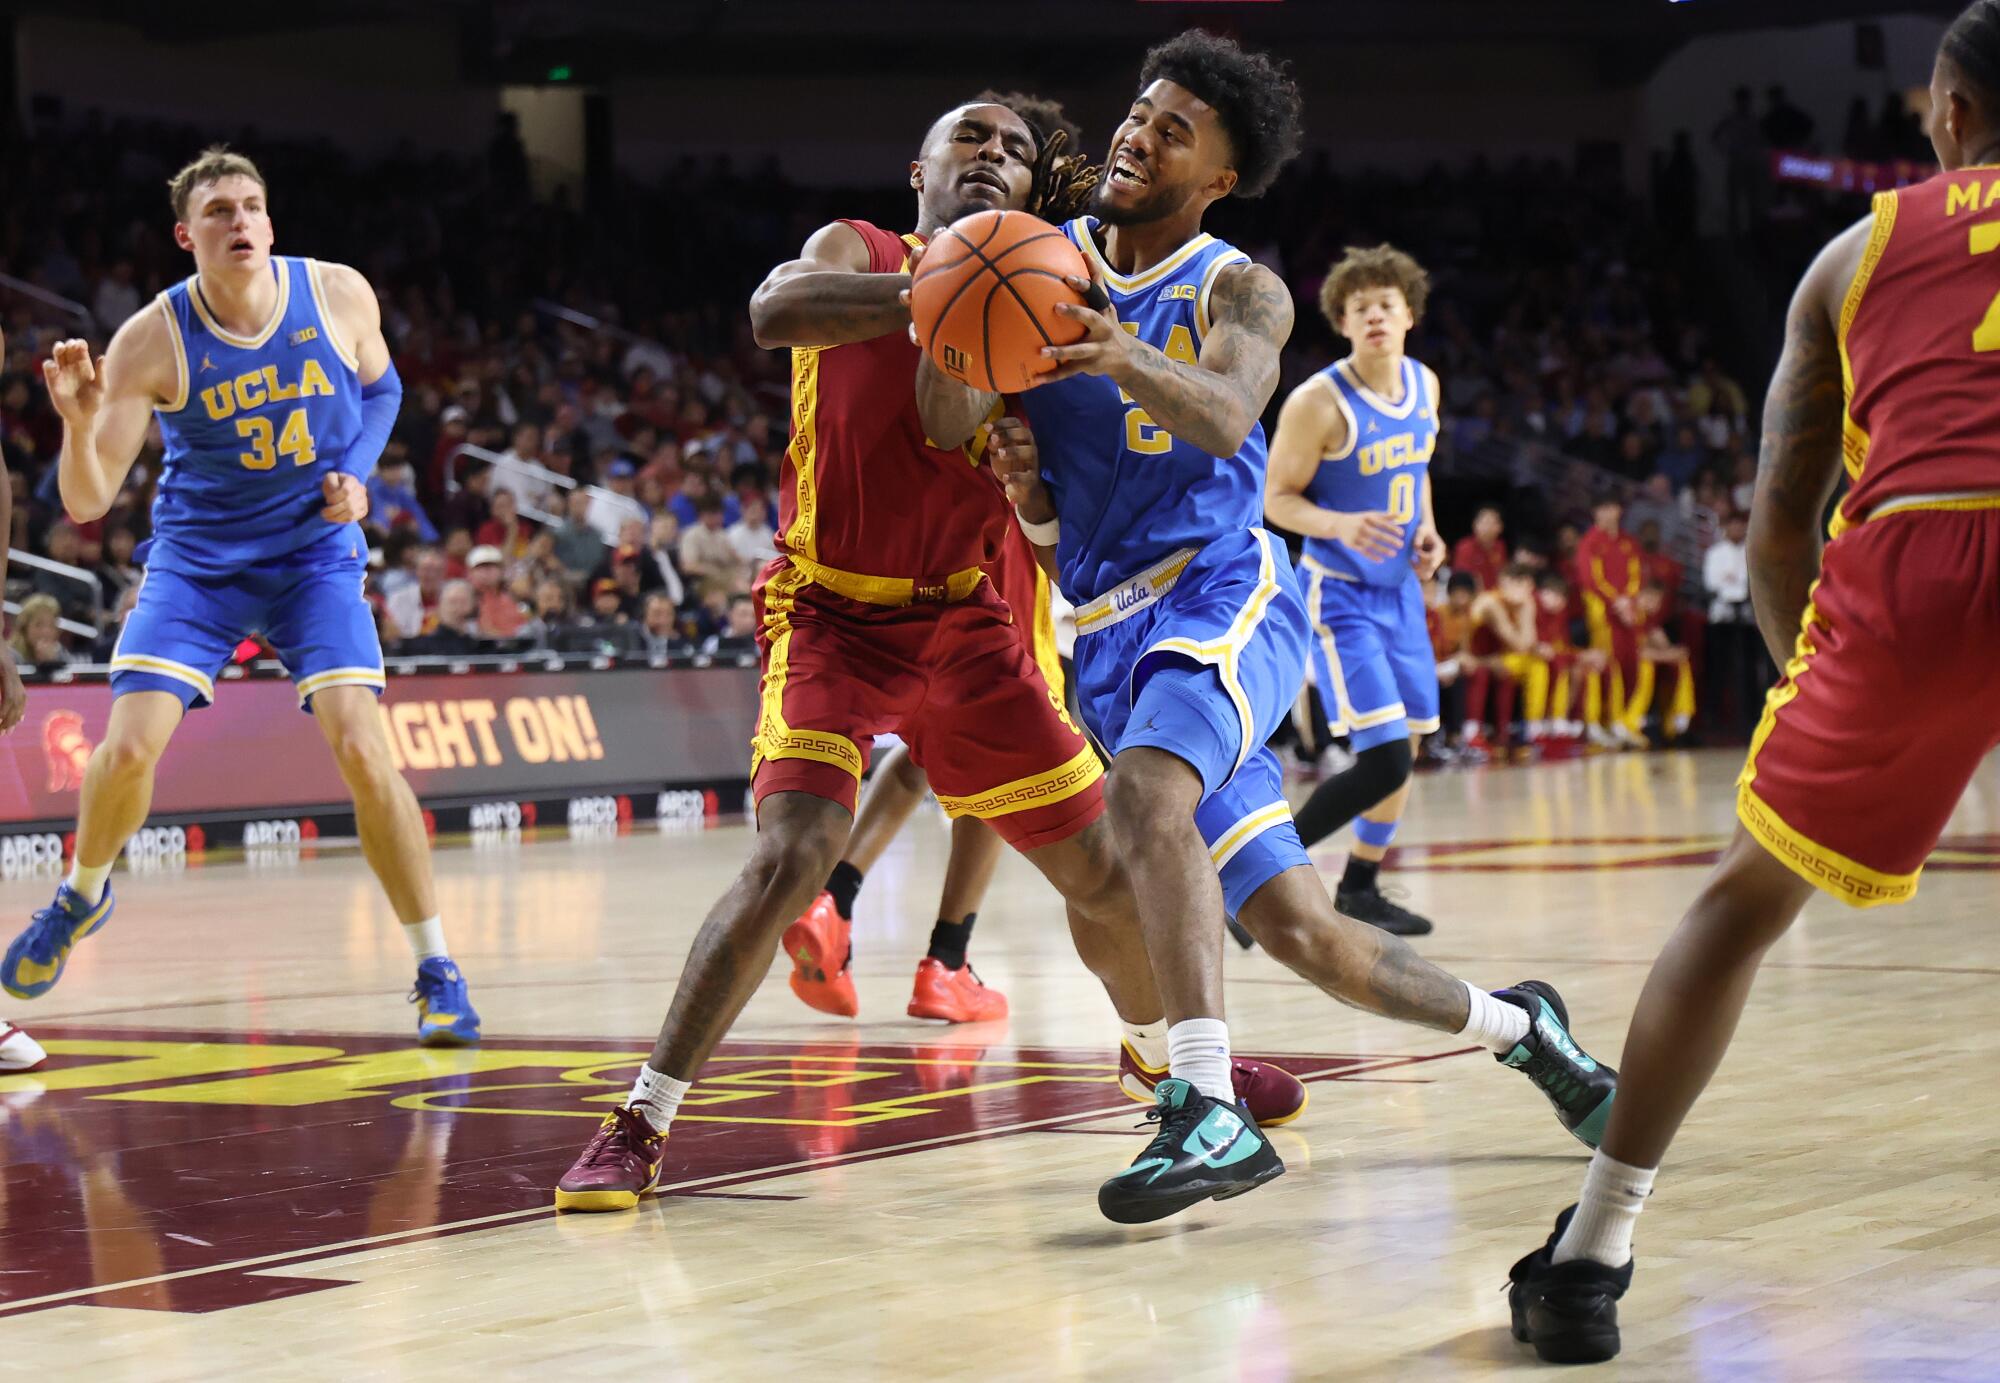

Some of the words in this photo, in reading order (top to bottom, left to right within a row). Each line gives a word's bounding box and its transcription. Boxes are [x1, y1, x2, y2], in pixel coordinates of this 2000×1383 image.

[200, 359, 335, 421] UCLA
[235, 407, 317, 470] 34
[1388, 472, 1415, 525] 0
[379, 698, 503, 770] IGHT
[505, 695, 604, 763] ON!
